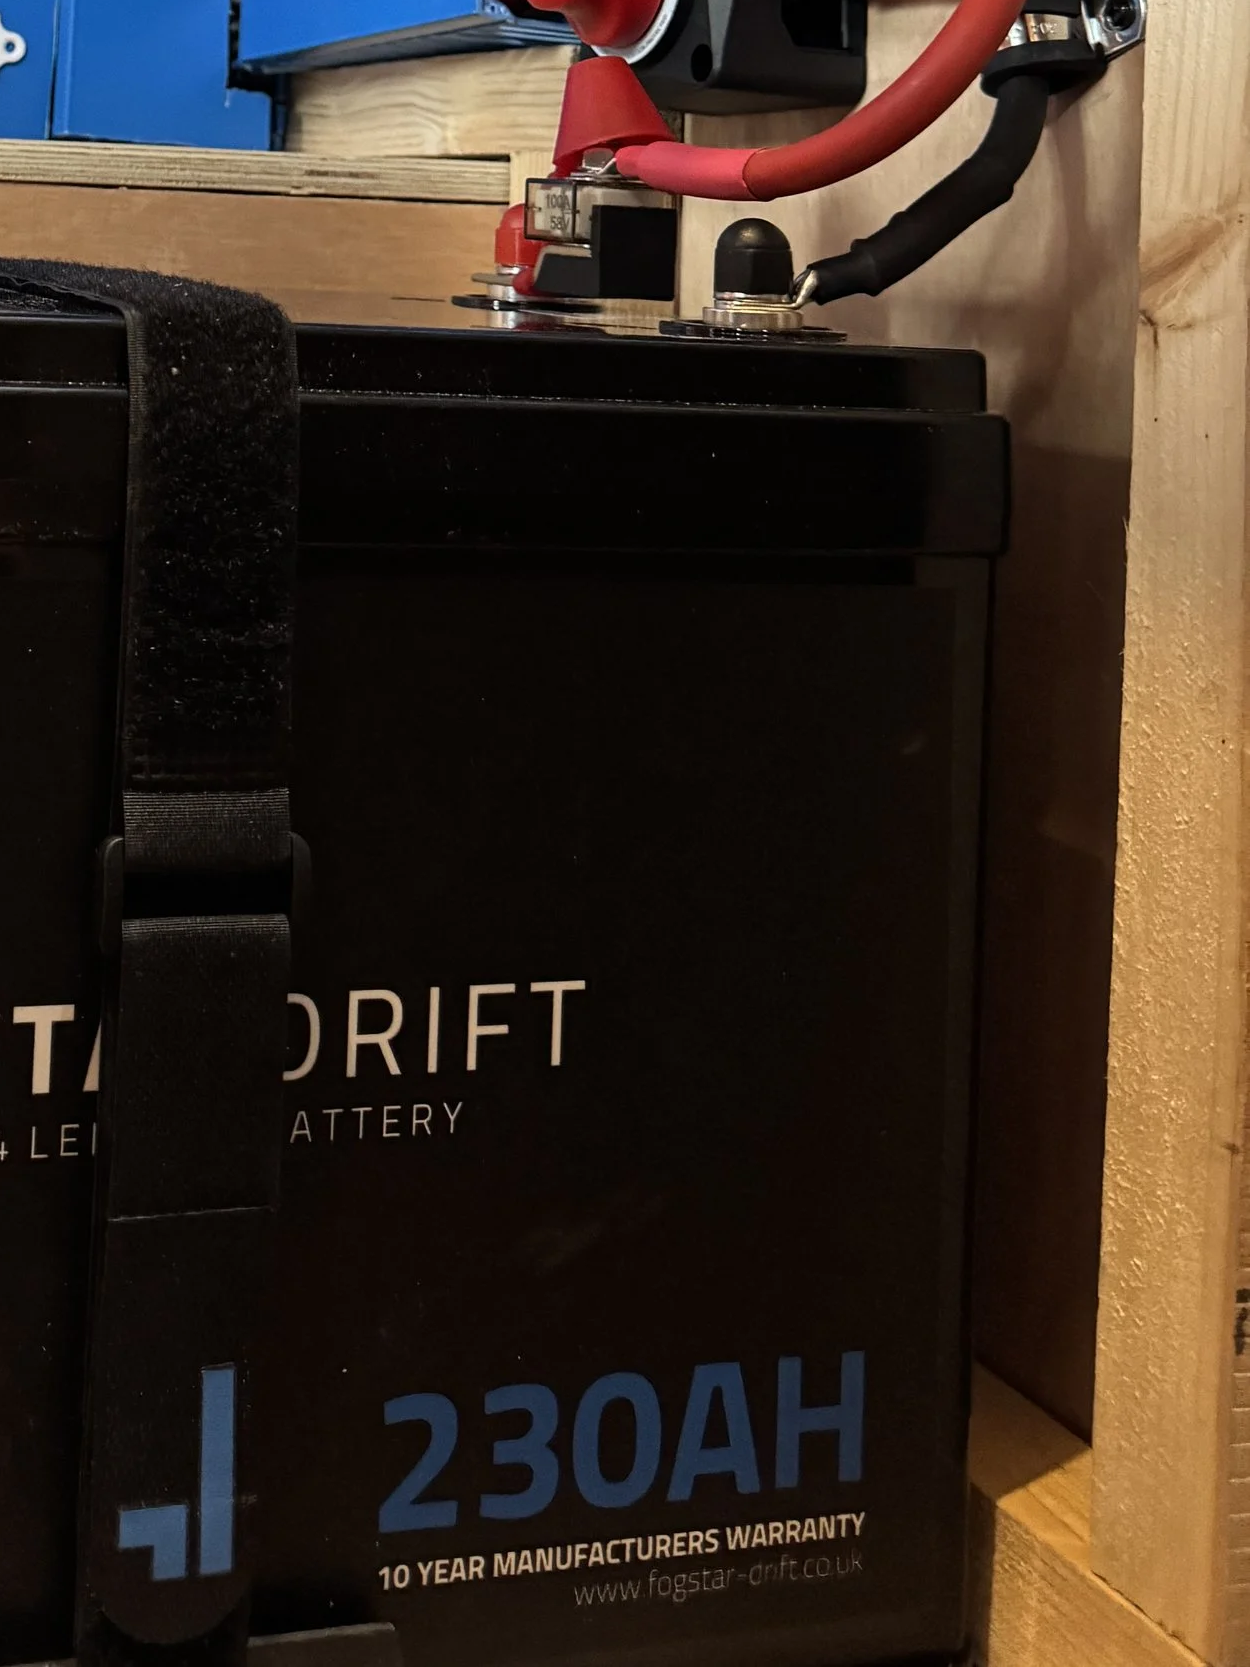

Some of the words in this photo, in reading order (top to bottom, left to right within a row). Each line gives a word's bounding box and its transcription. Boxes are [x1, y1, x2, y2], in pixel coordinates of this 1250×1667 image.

[289, 1100, 465, 1144] ATTERY
[378, 1350, 866, 1533] 230AH
[378, 1563, 409, 1591] 10
[418, 1556, 485, 1586] YEAR
[493, 1529, 719, 1578] MANUFACTURERS
[726, 1511, 866, 1550] WARRANTY
